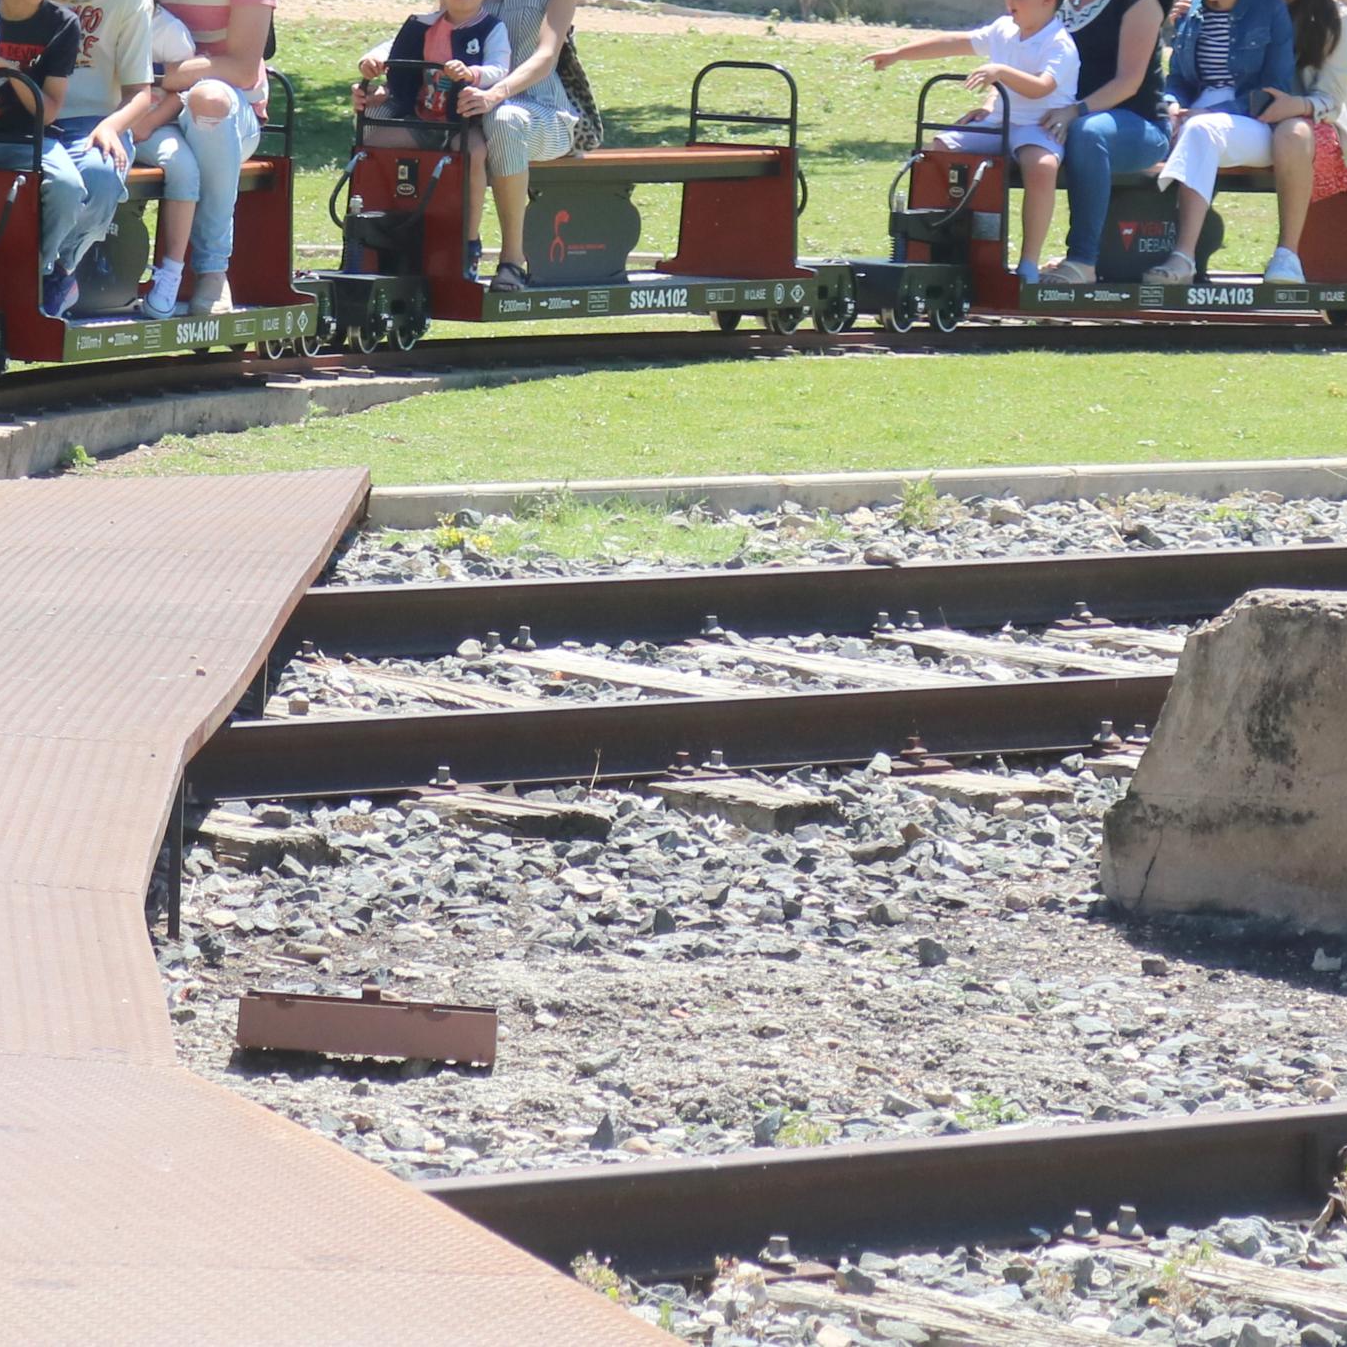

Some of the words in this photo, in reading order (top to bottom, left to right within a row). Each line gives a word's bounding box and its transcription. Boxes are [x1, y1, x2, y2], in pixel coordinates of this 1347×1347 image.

[630, 288, 688, 309] SSV-A102
[1187, 288, 1254, 305] SSV-A103
[1326, 292, 1345, 301] CLASE
[176, 320, 220, 344] SSV-A101
